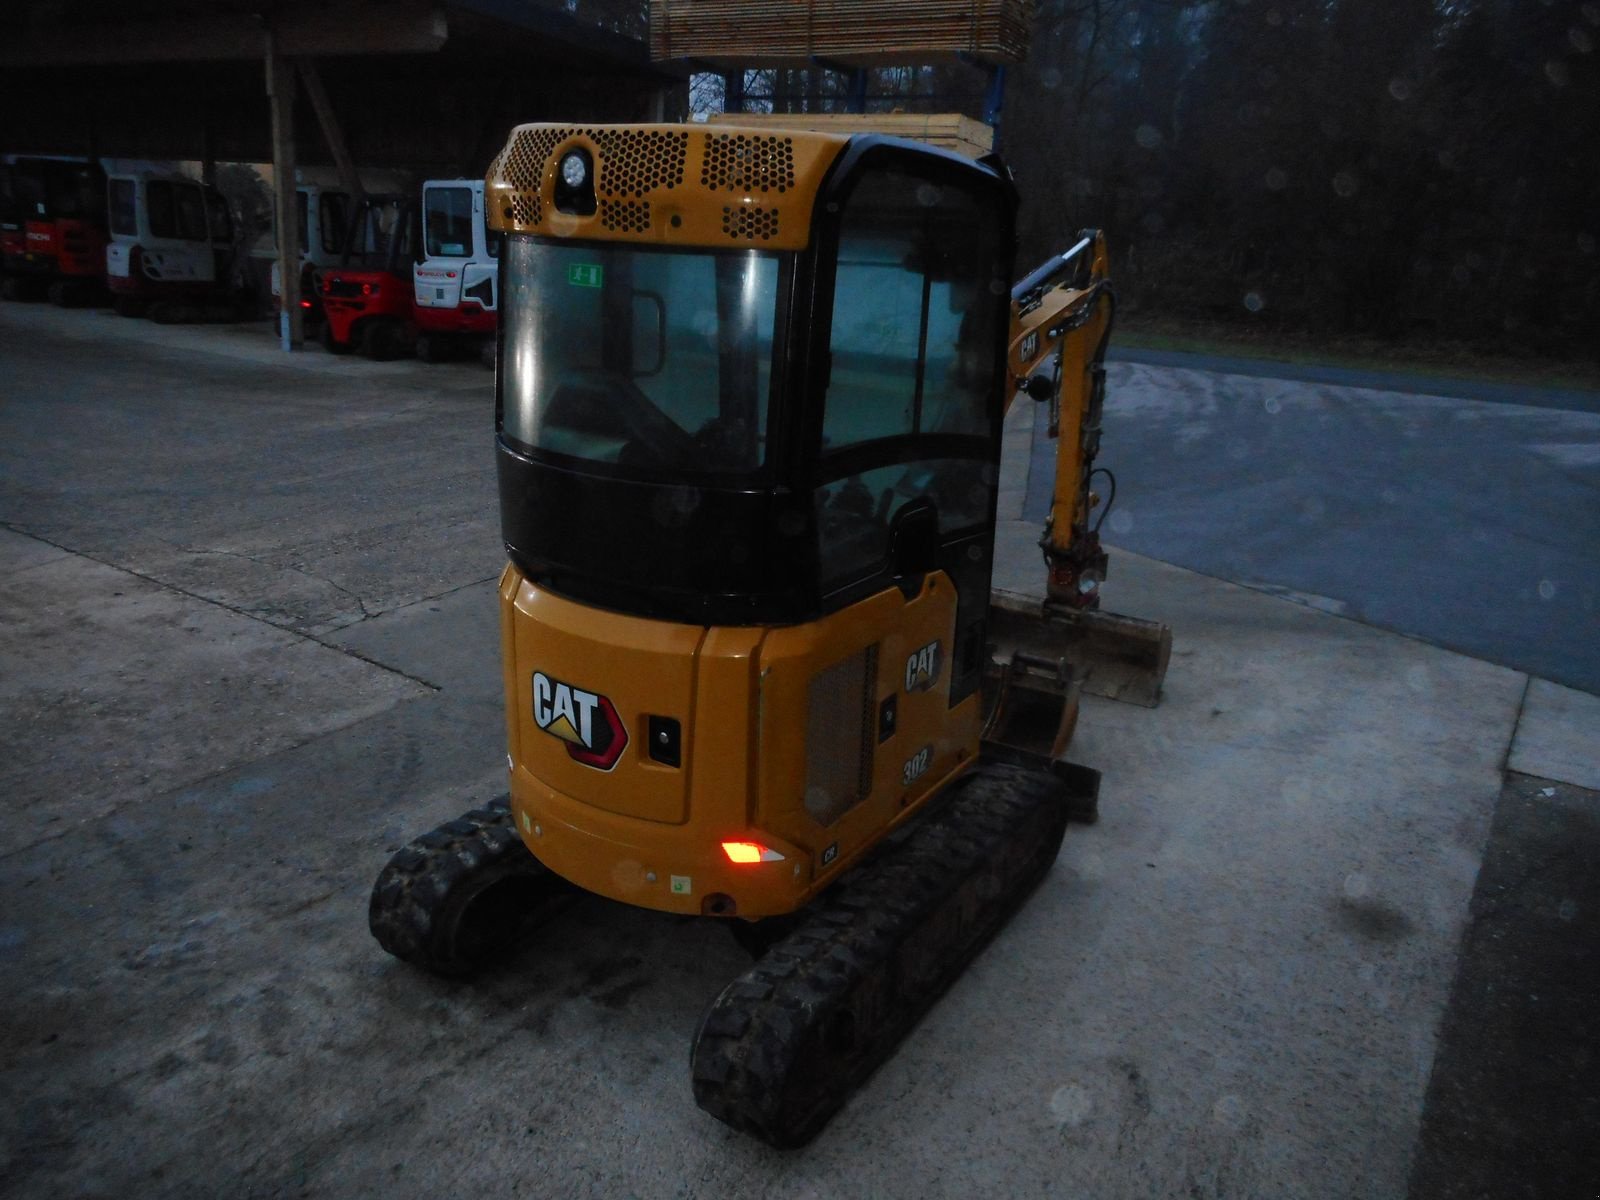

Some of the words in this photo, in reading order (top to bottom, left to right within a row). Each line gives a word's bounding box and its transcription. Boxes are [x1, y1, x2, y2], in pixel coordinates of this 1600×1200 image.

[905, 641, 938, 693] CAT
[533, 671, 599, 749] CAT
[903, 748, 929, 785] 302
